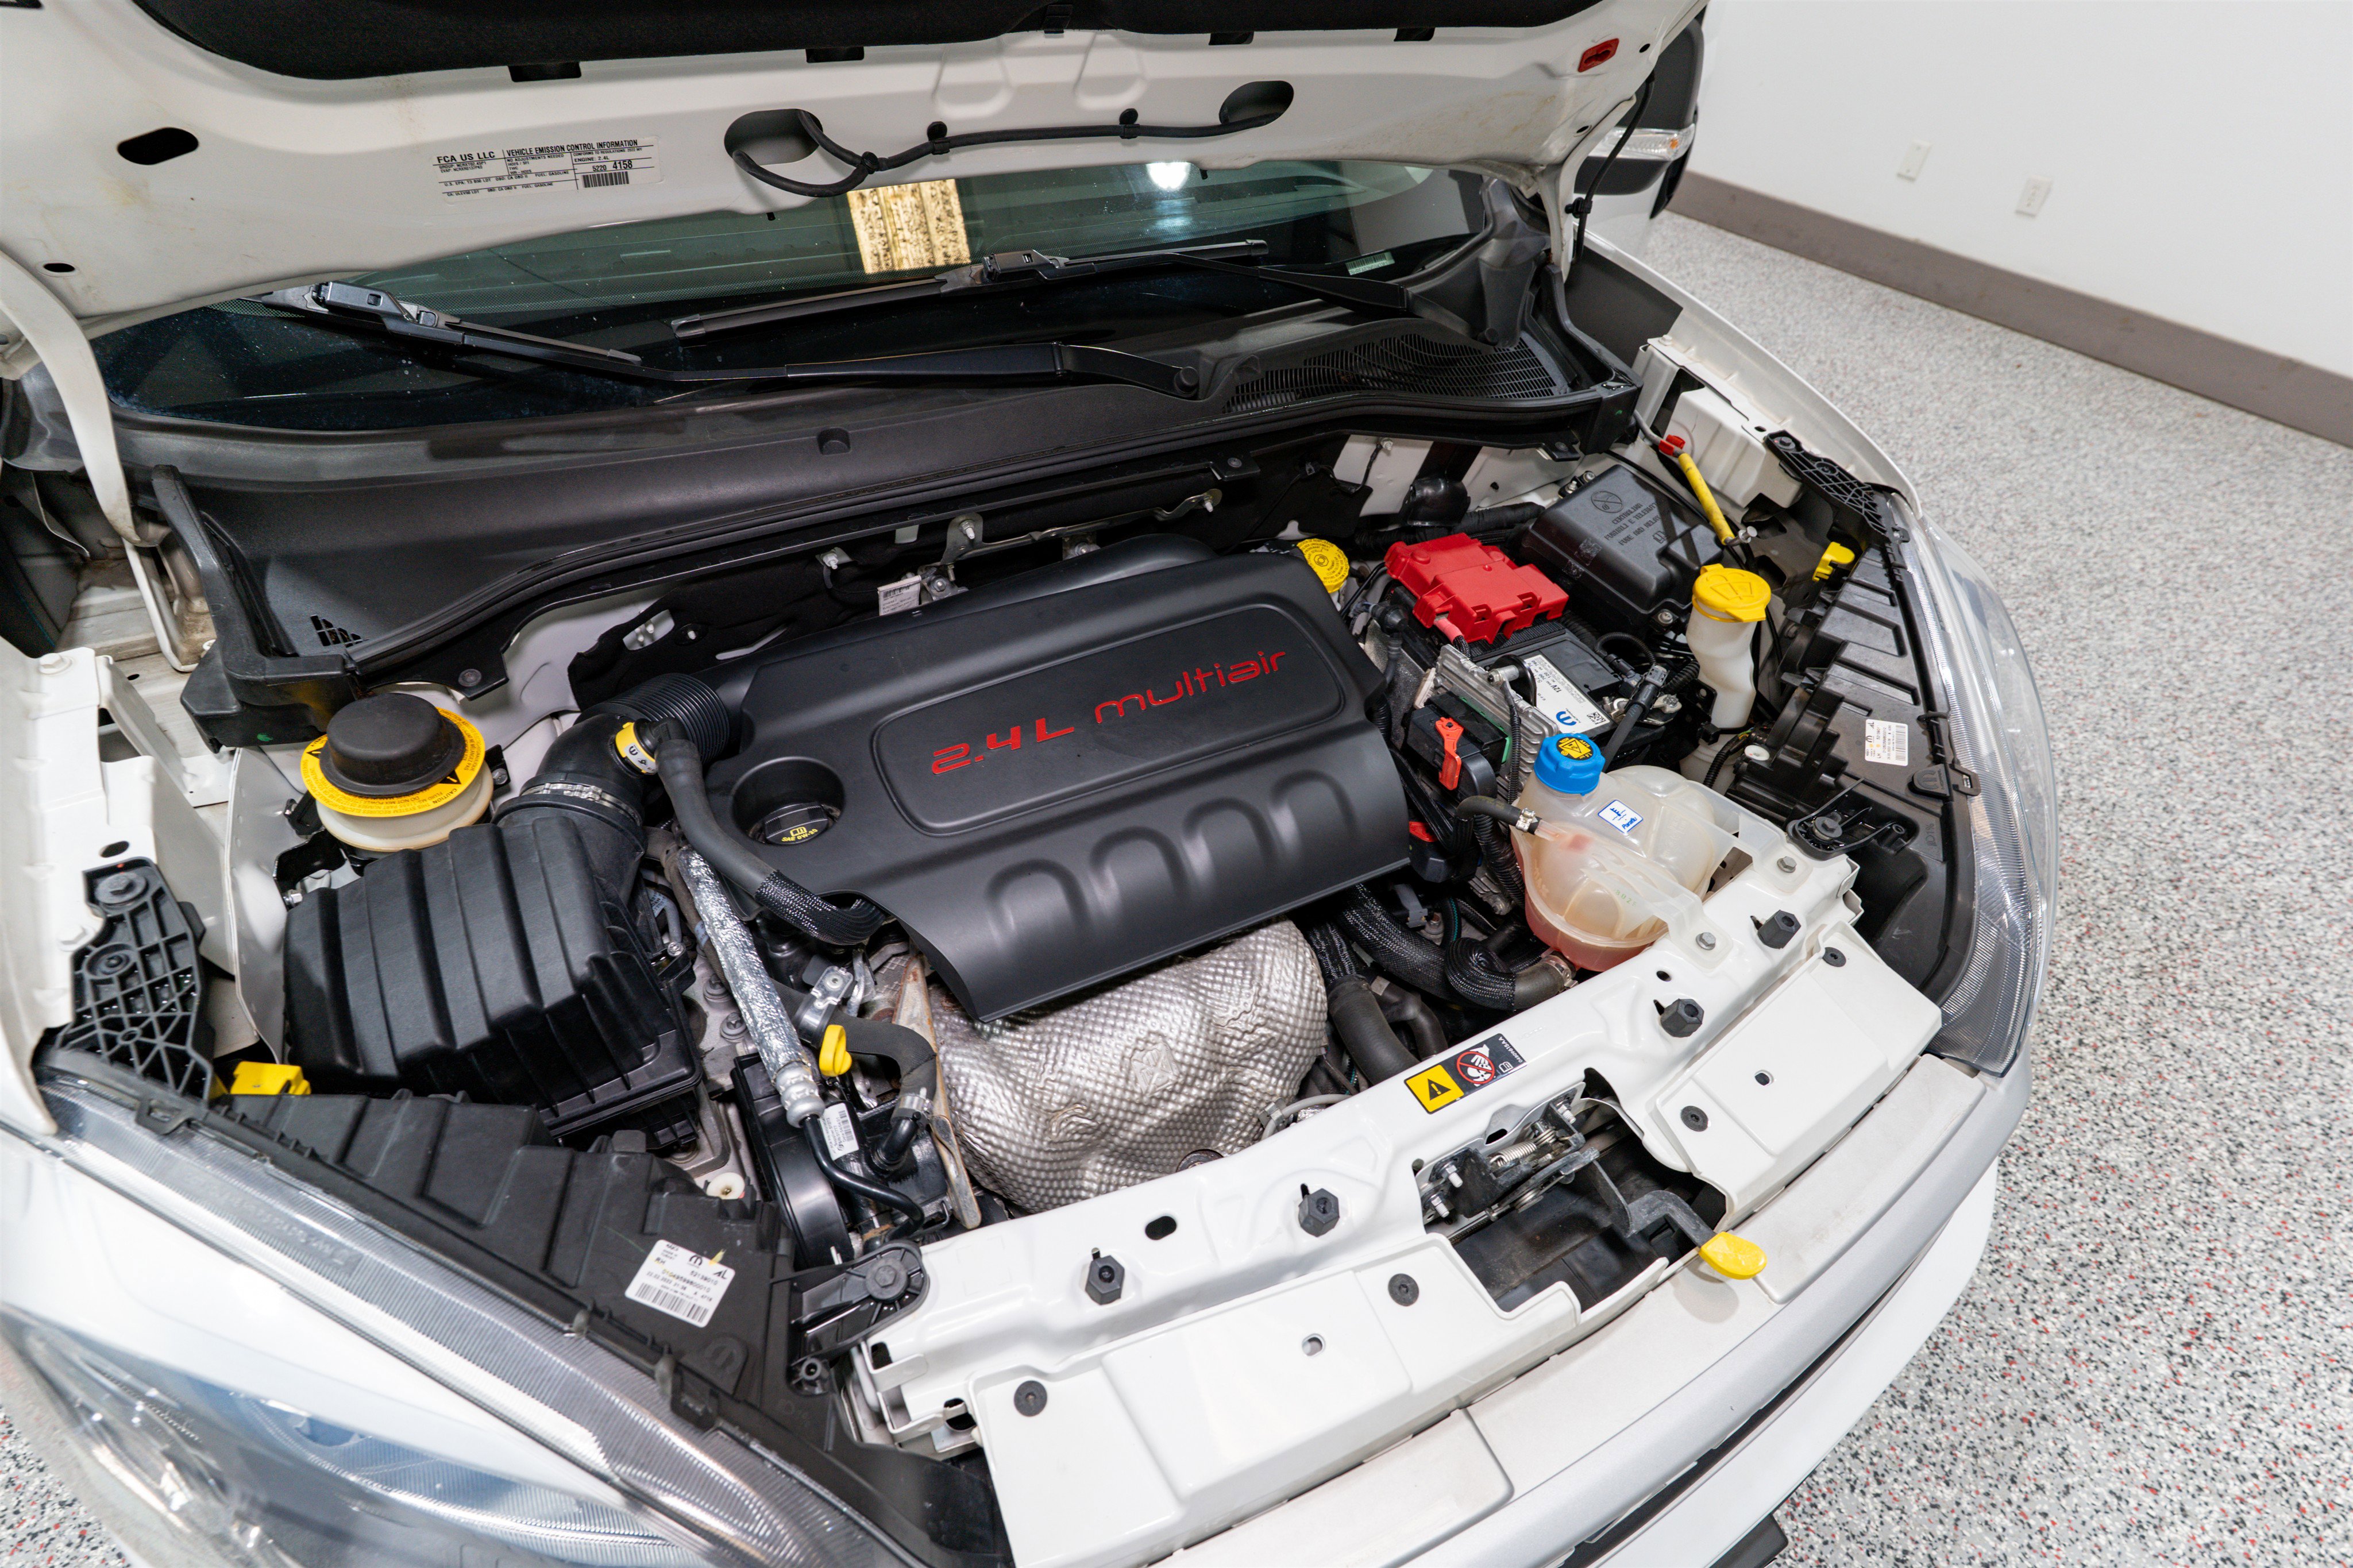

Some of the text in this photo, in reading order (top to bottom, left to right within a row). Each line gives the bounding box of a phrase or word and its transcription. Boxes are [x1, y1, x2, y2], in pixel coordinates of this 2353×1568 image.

[506, 138, 637, 157] VEHICLE EMISSION CONTROL INFORMATION
[437, 150, 495, 164] FCA US LLC
[612, 160, 632, 169] 4158
[1618, 533, 1634, 547] FUSE
[1632, 525, 1645, 536] AND
[1094, 651, 1286, 724] multiair
[1550, 682, 1561, 694] 12V
[431, 787, 459, 804] CAUTION
[1621, 816, 1638, 829] Paraflu
[797, 828, 818, 840] 0W-20
[1498, 1036, 1523, 1064] 04809615AA
[654, 1257, 666, 1265] RH
